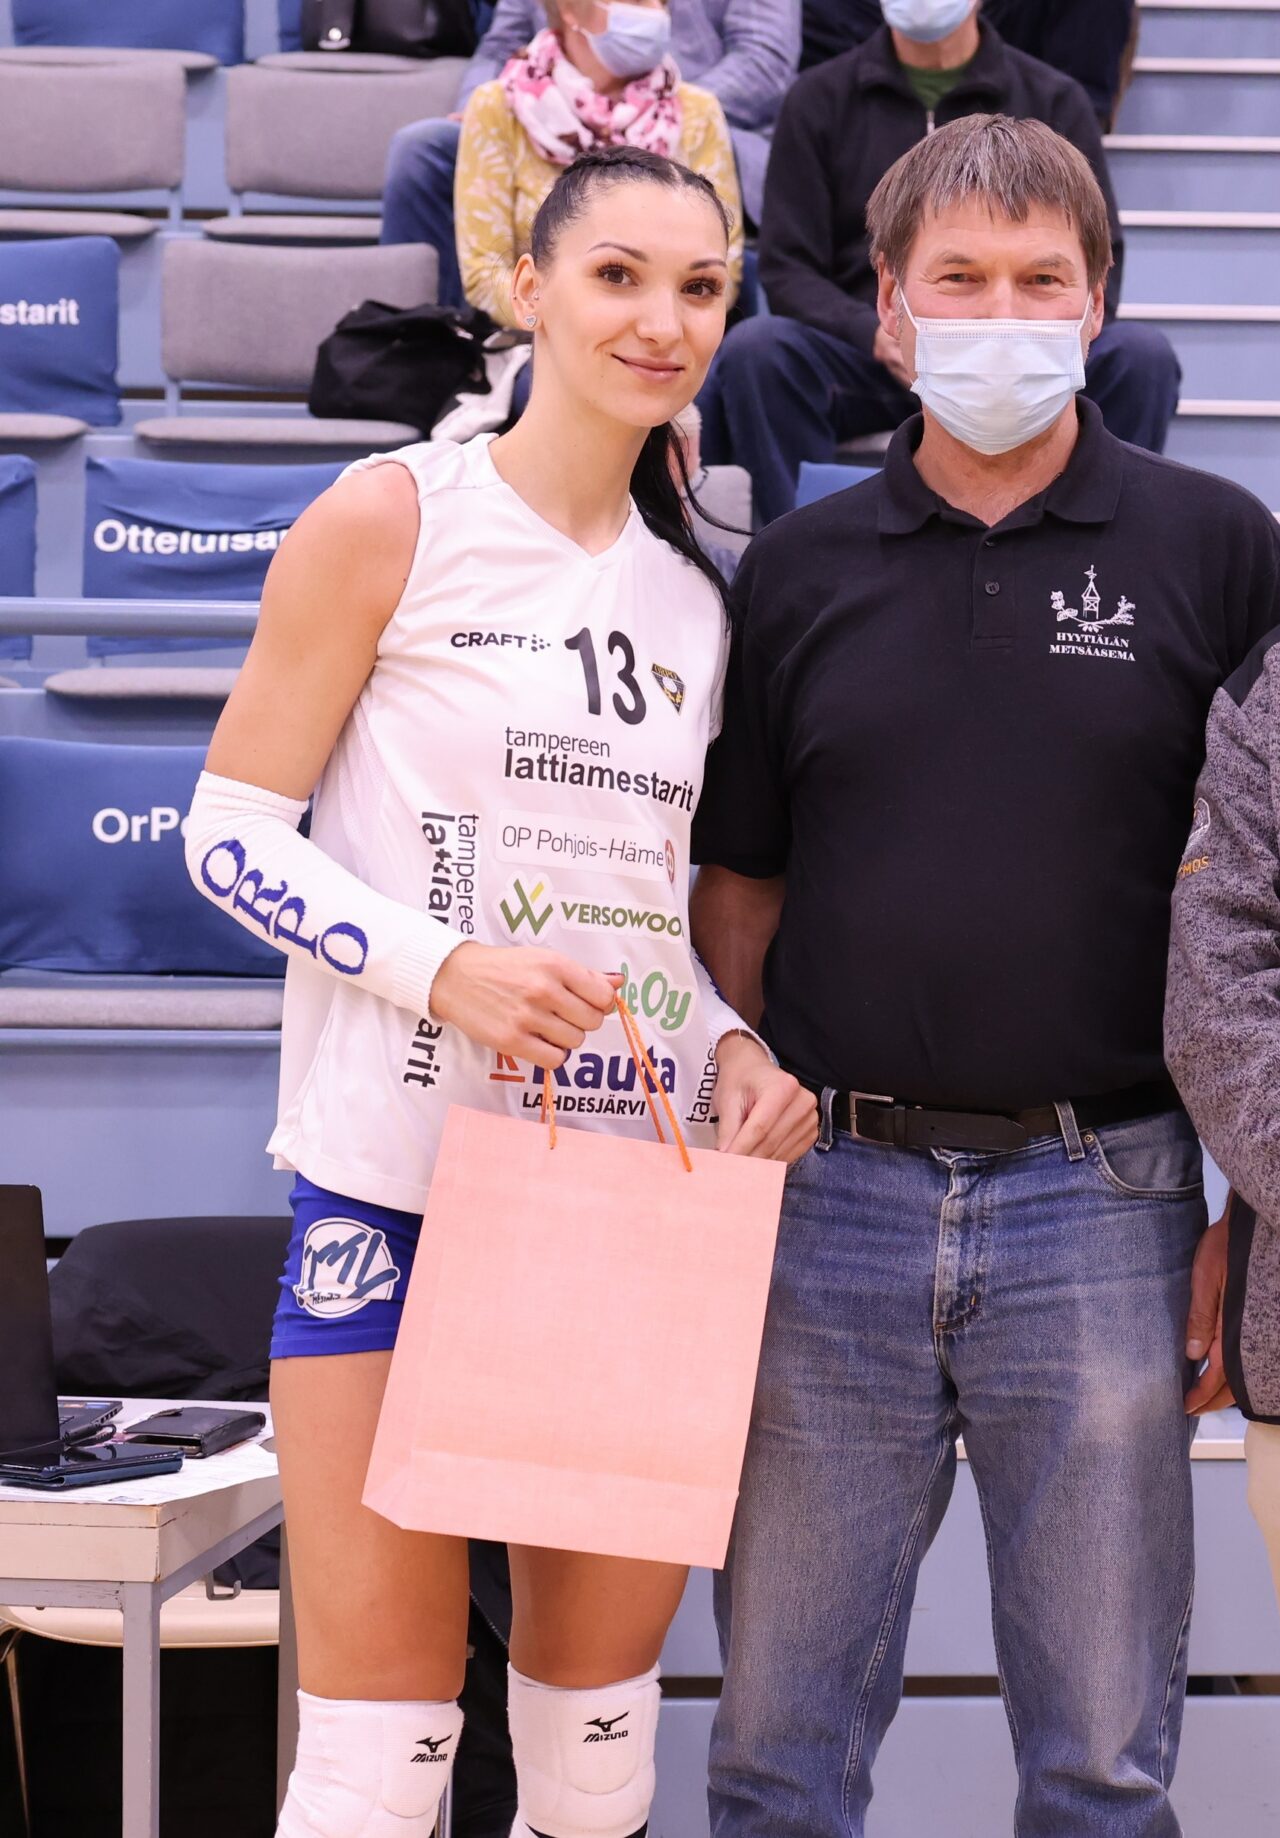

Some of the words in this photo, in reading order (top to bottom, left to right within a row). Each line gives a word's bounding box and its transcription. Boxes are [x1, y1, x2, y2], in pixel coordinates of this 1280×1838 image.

[0, 298, 79, 325] starit
[450, 632, 527, 649] CRAFT
[1049, 644, 1136, 662] METSÄASEMA
[1056, 632, 1130, 648] HYYTIÄLÄN
[564, 626, 647, 726] 13
[505, 726, 611, 758] tampereen
[504, 748, 694, 812] lattiamestarit
[502, 825, 532, 848] OP
[536, 829, 664, 867] Pohjois-Häme
[452, 814, 480, 935] tamperee
[201, 839, 368, 976] ORPO
[560, 901, 684, 938] VERSOWOO
[522, 1092, 646, 1116] LAHDESJÄRVI
